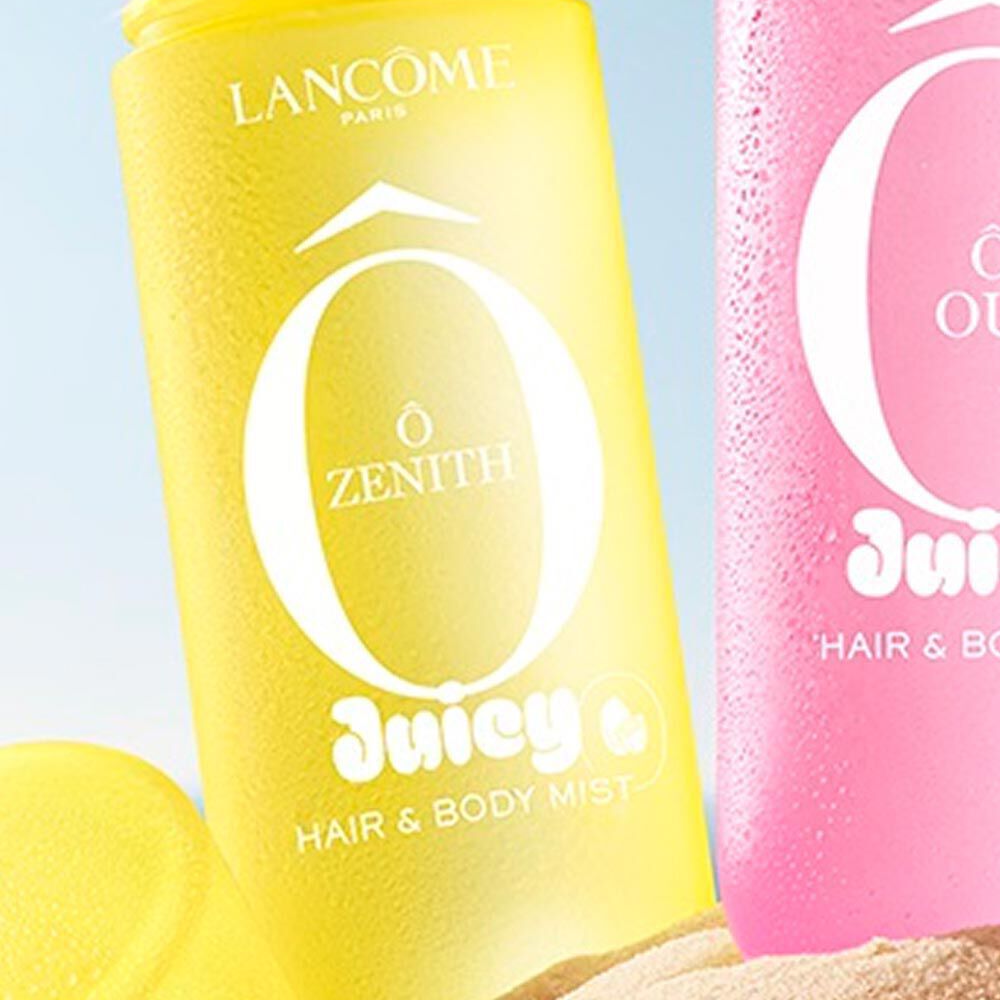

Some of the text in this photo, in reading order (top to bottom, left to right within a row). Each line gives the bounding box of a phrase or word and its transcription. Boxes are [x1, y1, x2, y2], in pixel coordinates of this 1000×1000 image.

[229, 44, 516, 126] LANCÔME
[340, 103, 407, 126] PARIS
[243, 180, 604, 702] Ô
[395, 400, 433, 448] Ô
[326, 443, 517, 510] ZENITH
[819, 631, 909, 660] HAIR
[923, 632, 946, 660] &
[331, 681, 582, 784] Juicy
[296, 775, 635, 854] HAIR & BODY MIST
